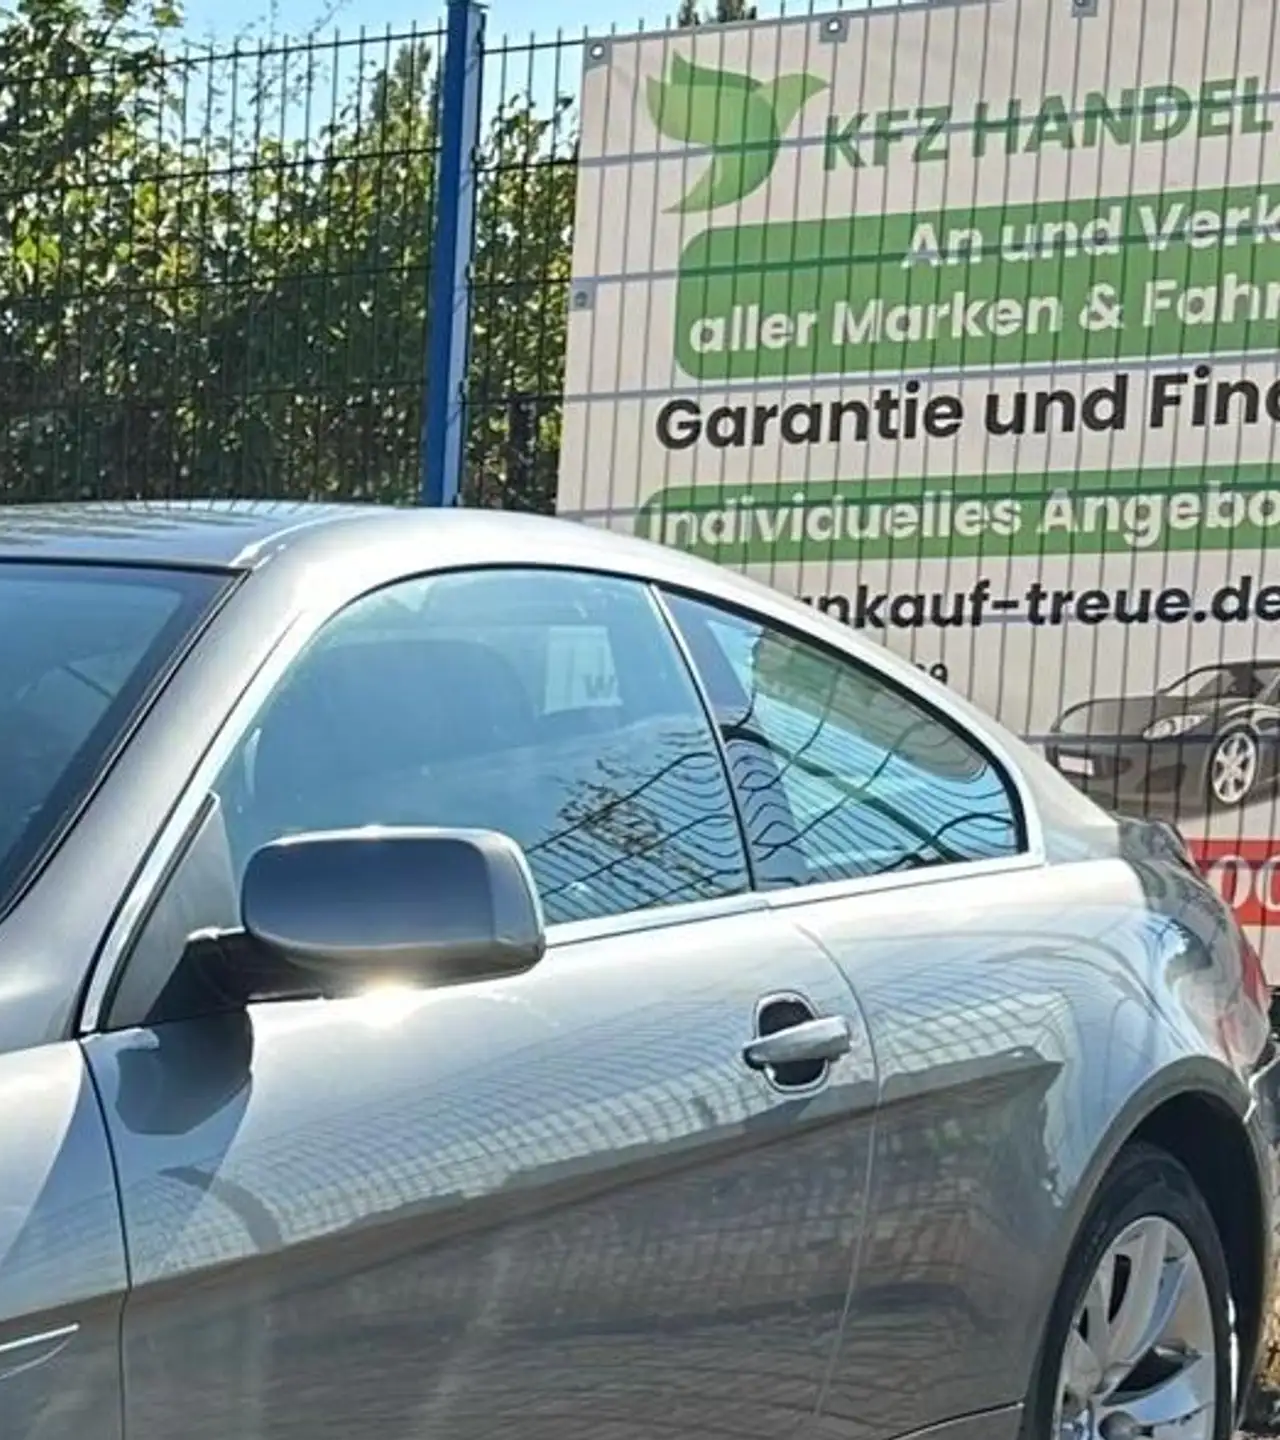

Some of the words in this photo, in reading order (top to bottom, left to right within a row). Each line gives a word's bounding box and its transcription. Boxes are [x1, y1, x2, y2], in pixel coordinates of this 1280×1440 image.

[823, 105, 953, 171] KFZ
[971, 76, 1274, 158] HANDEL
[901, 221, 983, 269] An
[1002, 204, 1123, 262] und
[689, 303, 817, 353] aller
[832, 290, 1062, 346] Marken
[1078, 282, 1125, 331] &
[655, 379, 964, 450] Garantie
[984, 373, 1128, 436] und
[650, 490, 1022, 547] Individuelles
